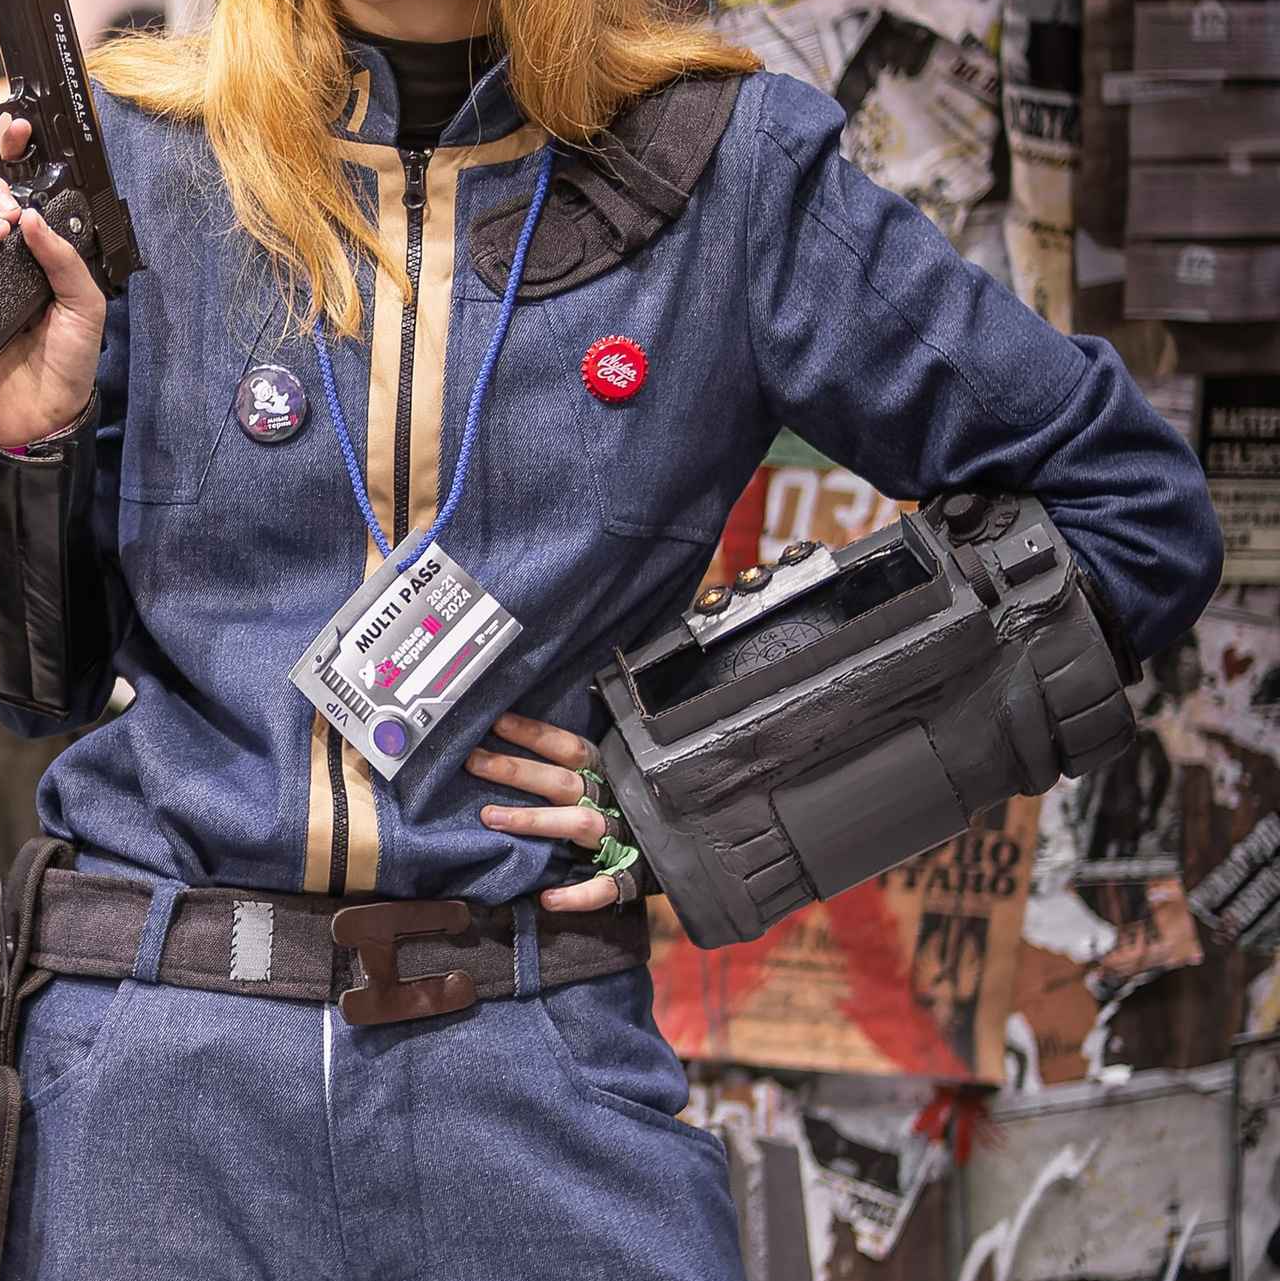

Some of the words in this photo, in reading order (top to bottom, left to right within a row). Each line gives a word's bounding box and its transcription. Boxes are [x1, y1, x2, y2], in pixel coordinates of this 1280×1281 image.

[597, 353, 637, 382] Nuka
[597, 367, 628, 388] Cola
[426, 574, 456, 607] 20-21
[434, 582, 462, 612] января
[441, 588, 472, 622] 2024
[355, 602, 402, 654] MULTI
[399, 559, 442, 604] PASS
[326, 703, 349, 728] VIP
